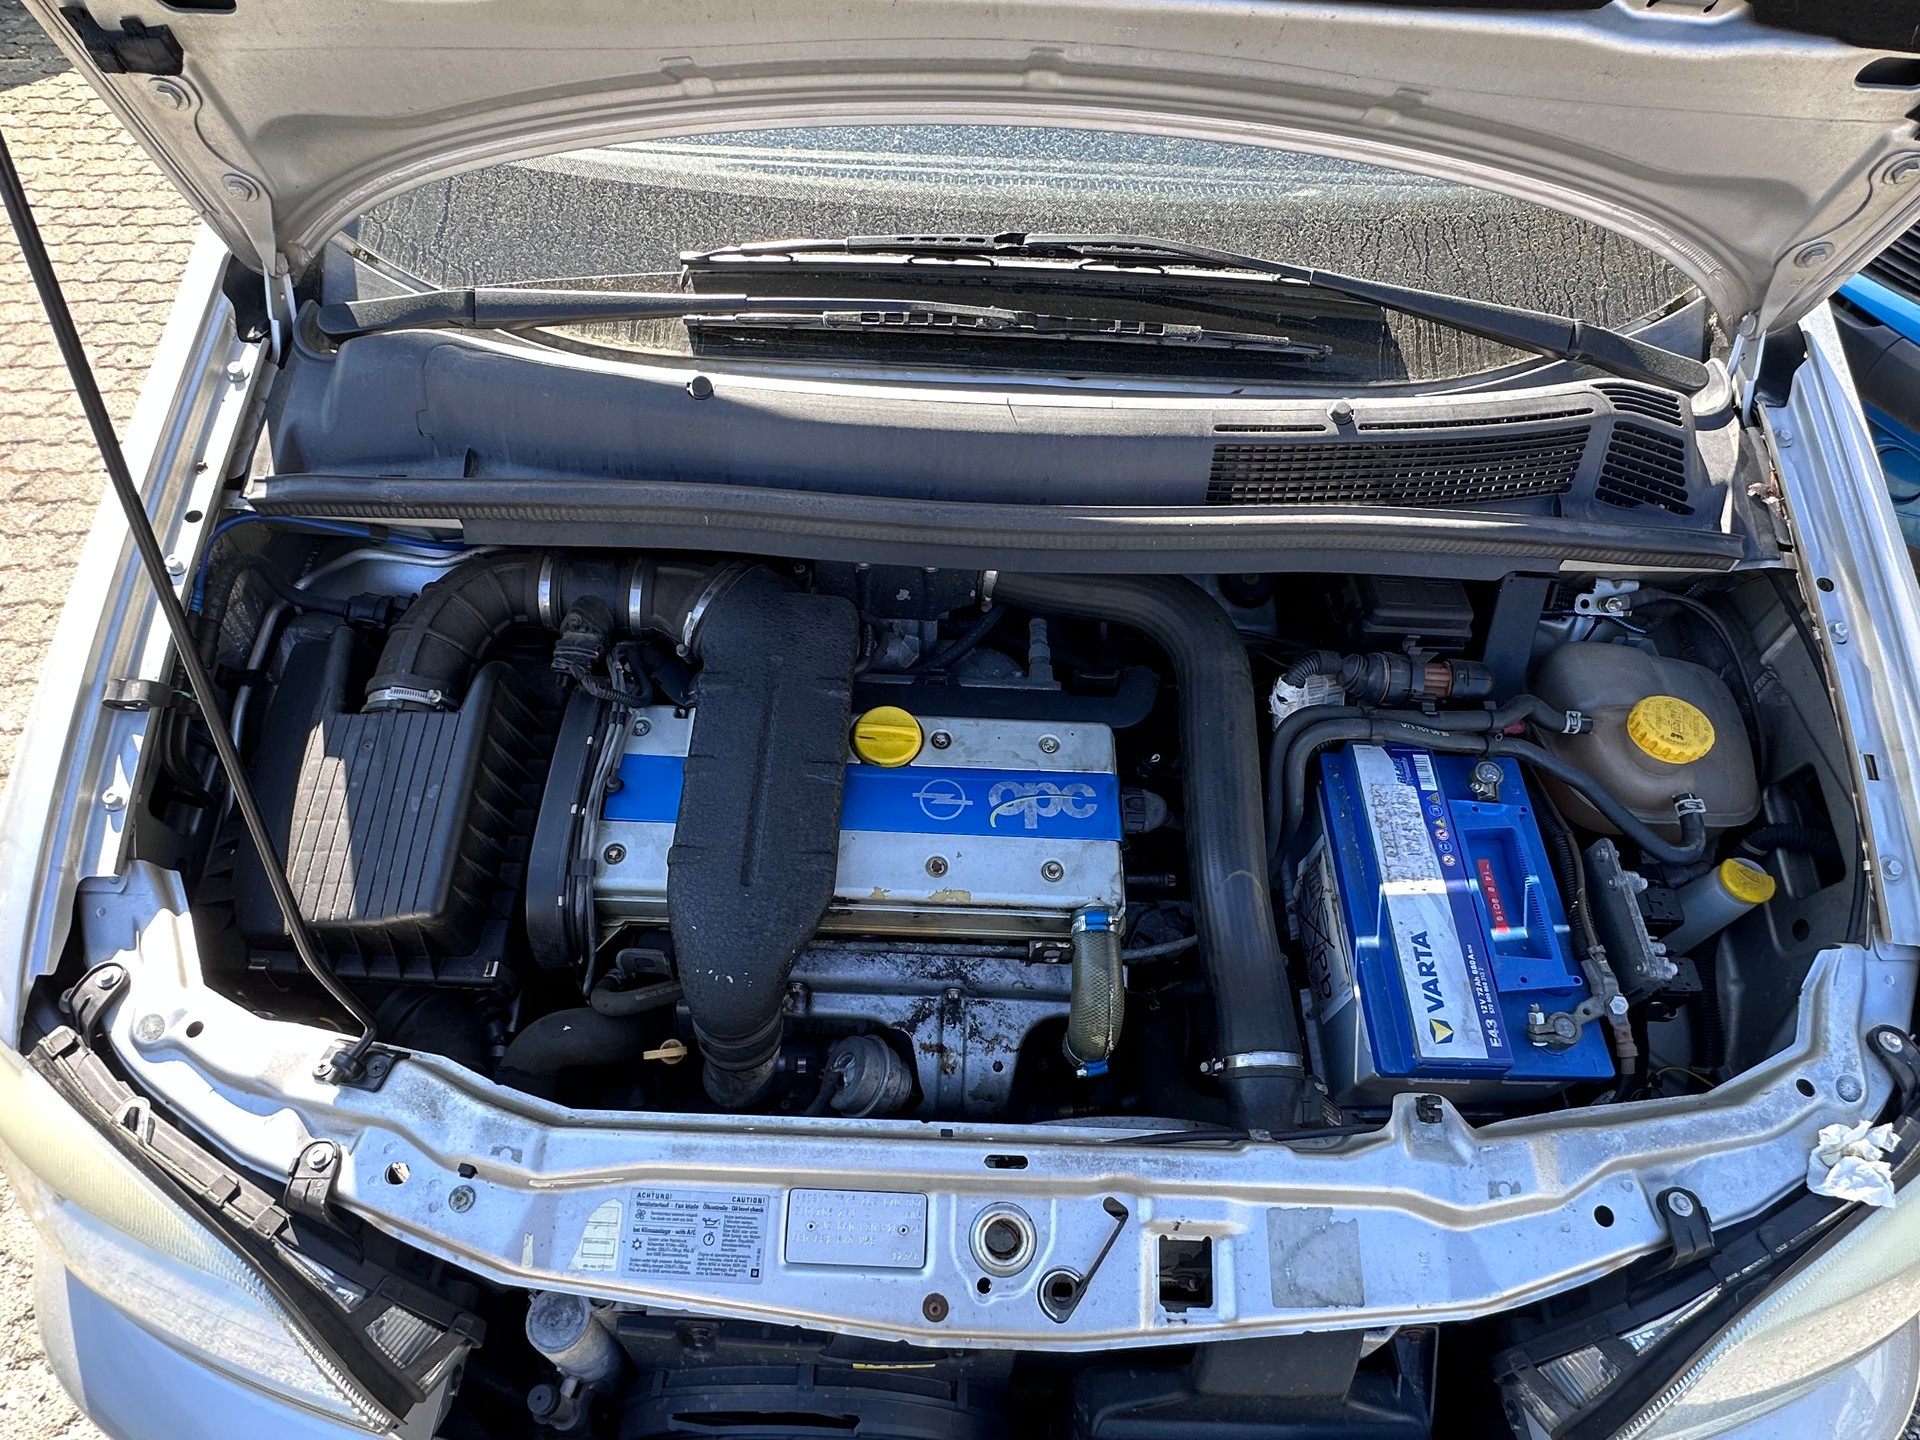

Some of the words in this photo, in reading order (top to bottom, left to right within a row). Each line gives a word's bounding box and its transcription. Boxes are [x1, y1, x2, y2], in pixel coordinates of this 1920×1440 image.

[1314, 948, 1332, 999] Pb
[1410, 930, 1445, 1014] VARTA
[1473, 976, 1485, 997] 72Ah
[1479, 998, 1489, 1015] 12V
[1485, 1018, 1503, 1048] E43
[636, 1192, 673, 1200] ACHTUNG!
[731, 1196, 766, 1204] CAUTION!
